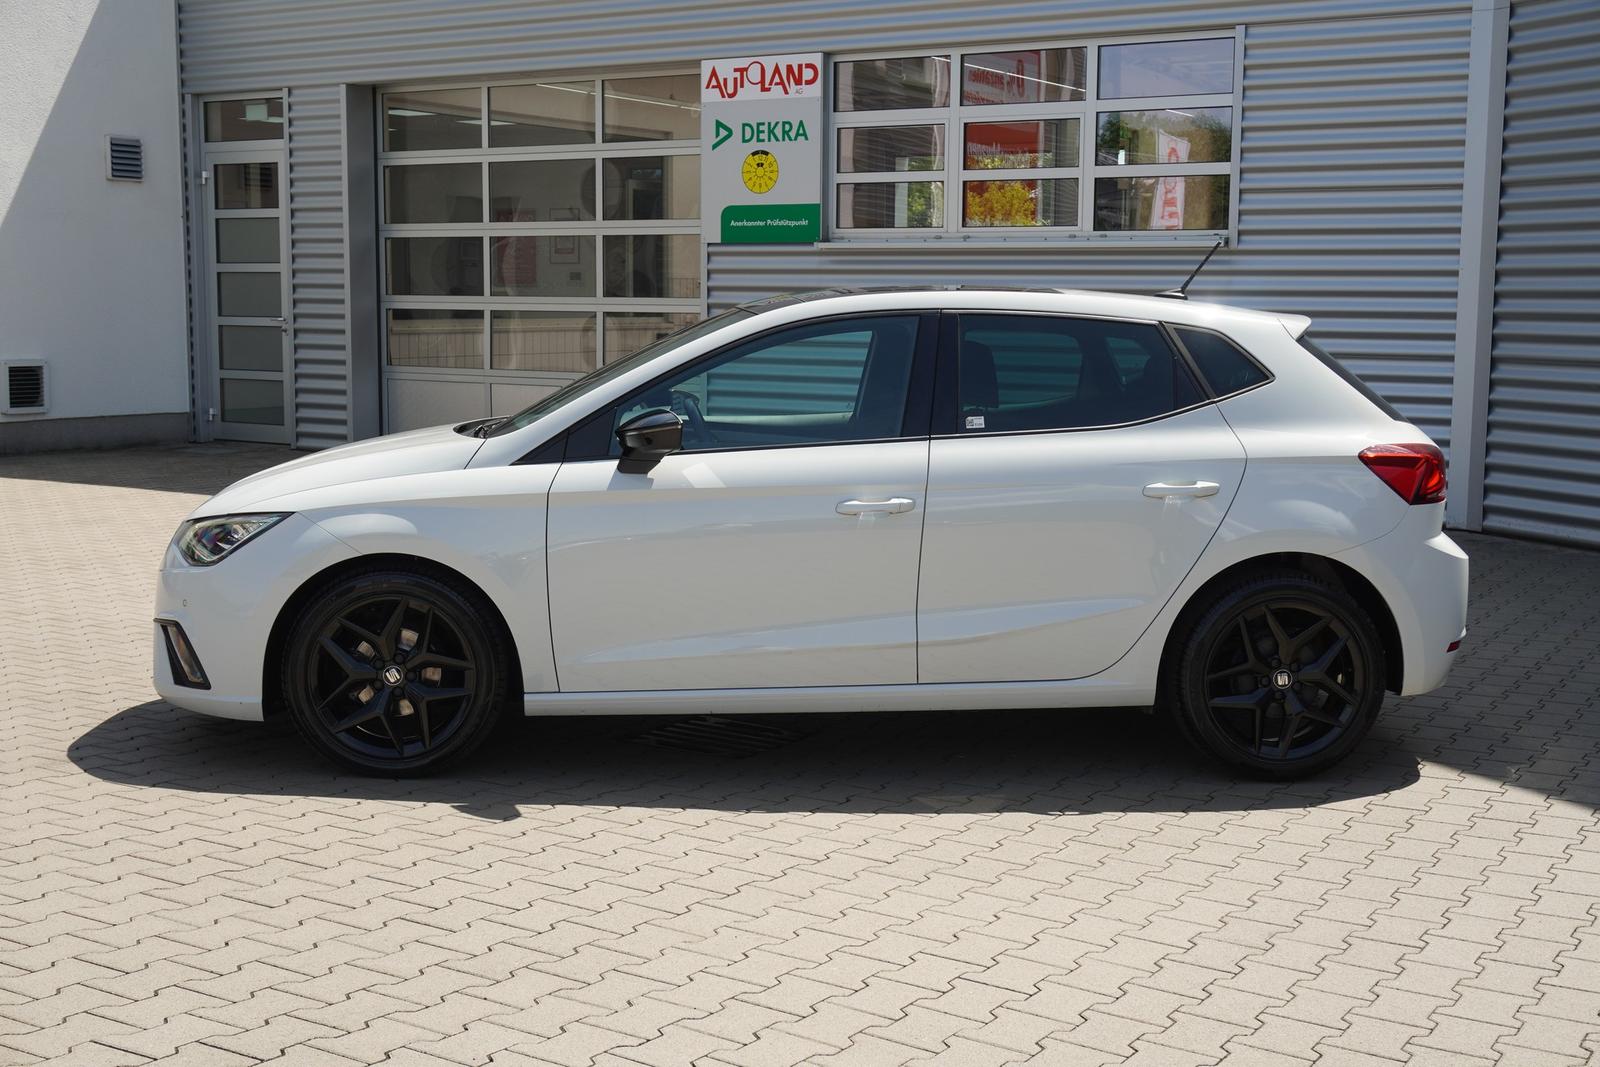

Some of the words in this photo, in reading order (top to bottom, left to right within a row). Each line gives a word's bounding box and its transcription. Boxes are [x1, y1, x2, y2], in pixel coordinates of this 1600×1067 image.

[705, 61, 819, 98] AUTOLAND
[741, 119, 809, 144] DEKRA
[730, 219, 766, 227] Anerkannter
[766, 217, 809, 228] Prüfstützpunkt
